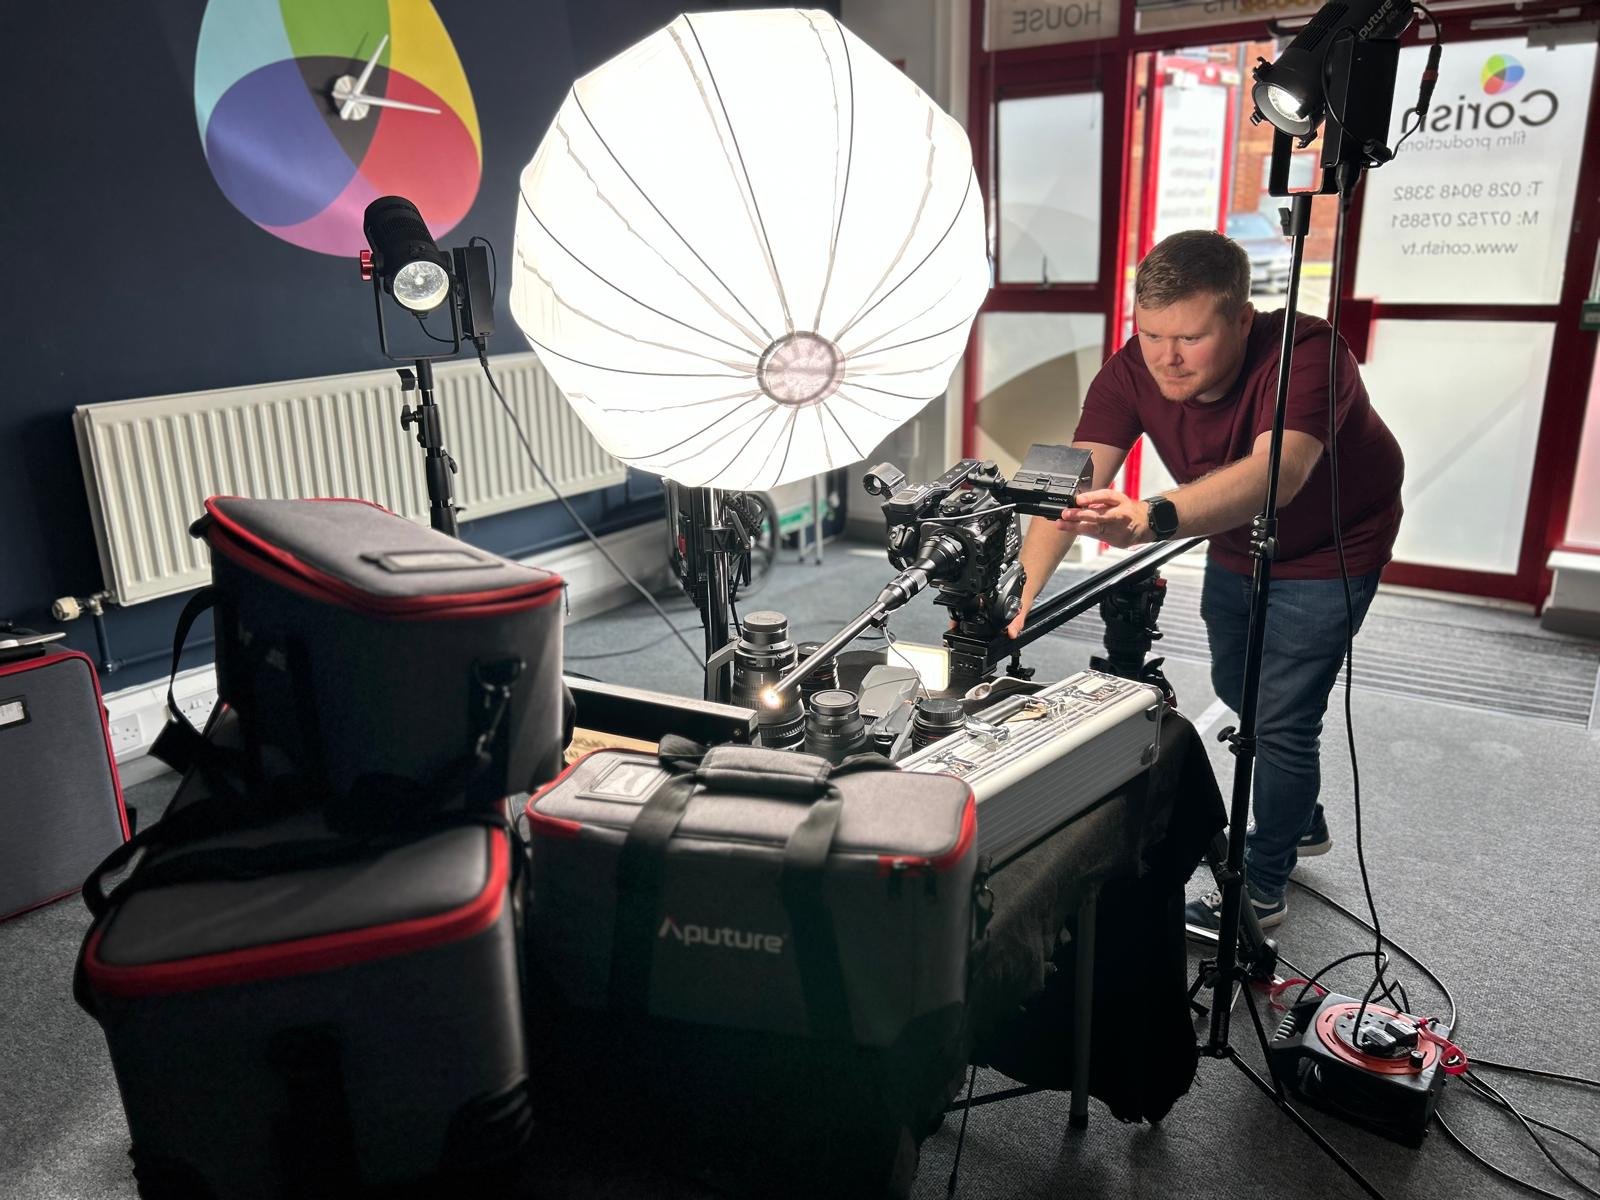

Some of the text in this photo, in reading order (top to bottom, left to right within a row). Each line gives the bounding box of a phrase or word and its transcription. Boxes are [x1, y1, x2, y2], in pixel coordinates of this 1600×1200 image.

[1358, 0, 1393, 41] puture
[1047, 495, 1069, 503] SONY
[658, 914, 784, 954] Aputure
